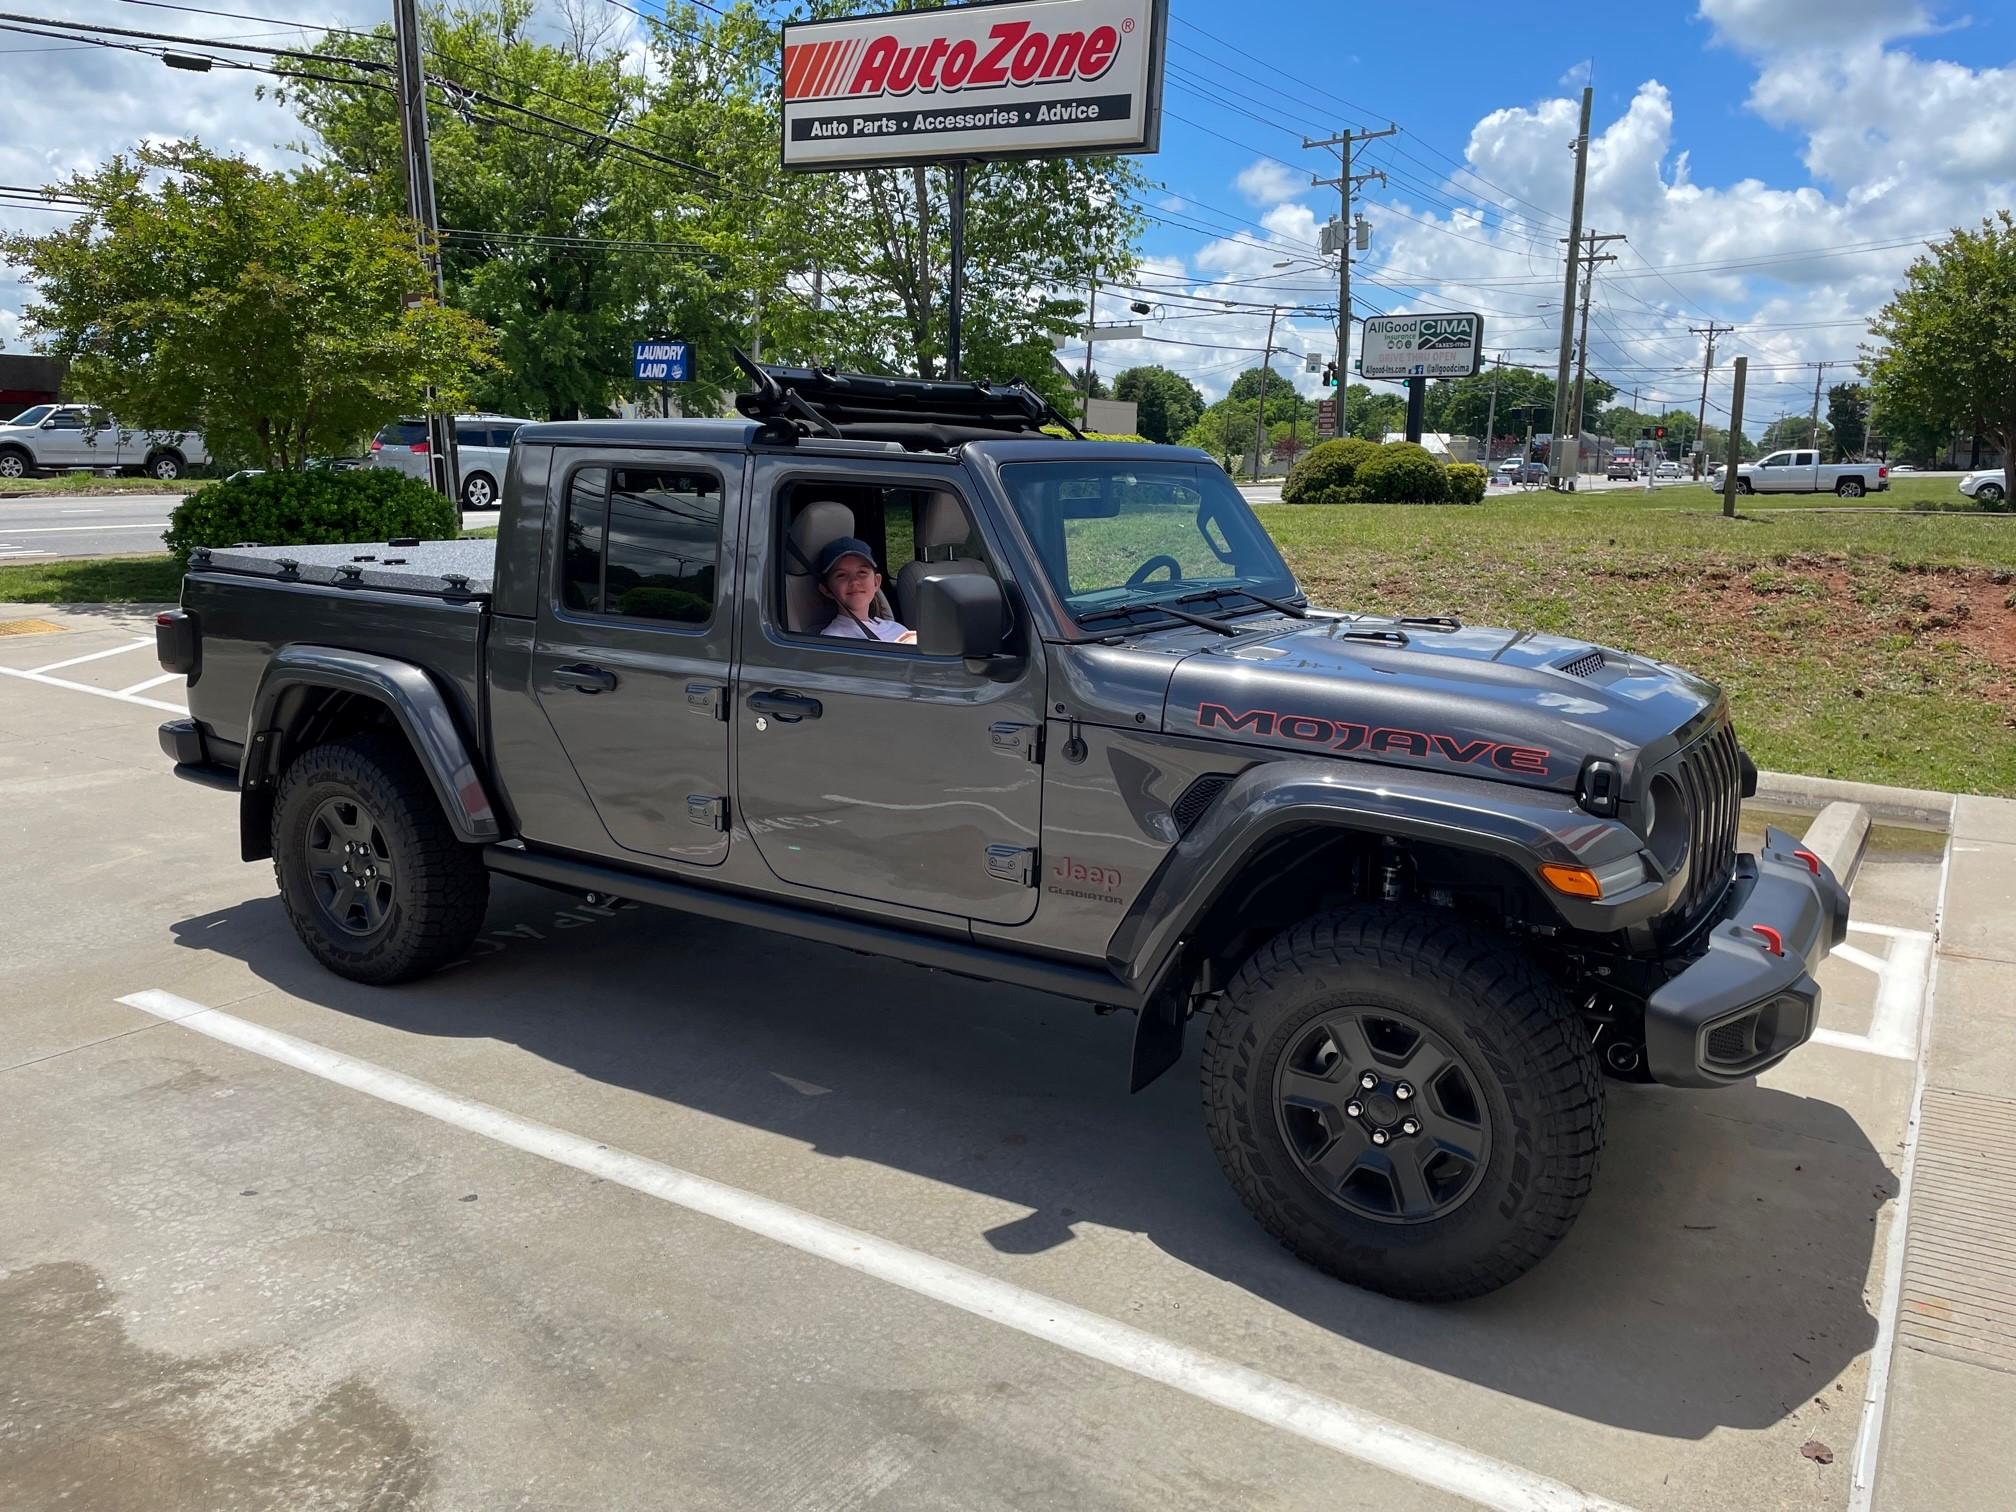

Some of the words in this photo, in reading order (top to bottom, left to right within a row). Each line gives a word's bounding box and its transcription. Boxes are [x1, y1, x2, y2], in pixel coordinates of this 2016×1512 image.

[811, 121, 848, 137] Auto
[853, 119, 897, 135] Parts
[913, 111, 1019, 132] Accessories
[1036, 103, 1100, 122] Advice
[1368, 320, 1417, 334] AllGood
[1420, 319, 1471, 334] CIMA
[1384, 333, 1416, 341] Insurance
[636, 345, 685, 361] LAUNDRY
[1379, 353, 1405, 363] DRIVE
[1406, 351, 1430, 362] THRU
[1432, 350, 1457, 361] OPEN
[639, 362, 668, 378] LAND
[1197, 702, 1550, 776] MOJAVE
[1052, 856, 1122, 893] Jeep
[1047, 885, 1124, 905] GLADIATOR
